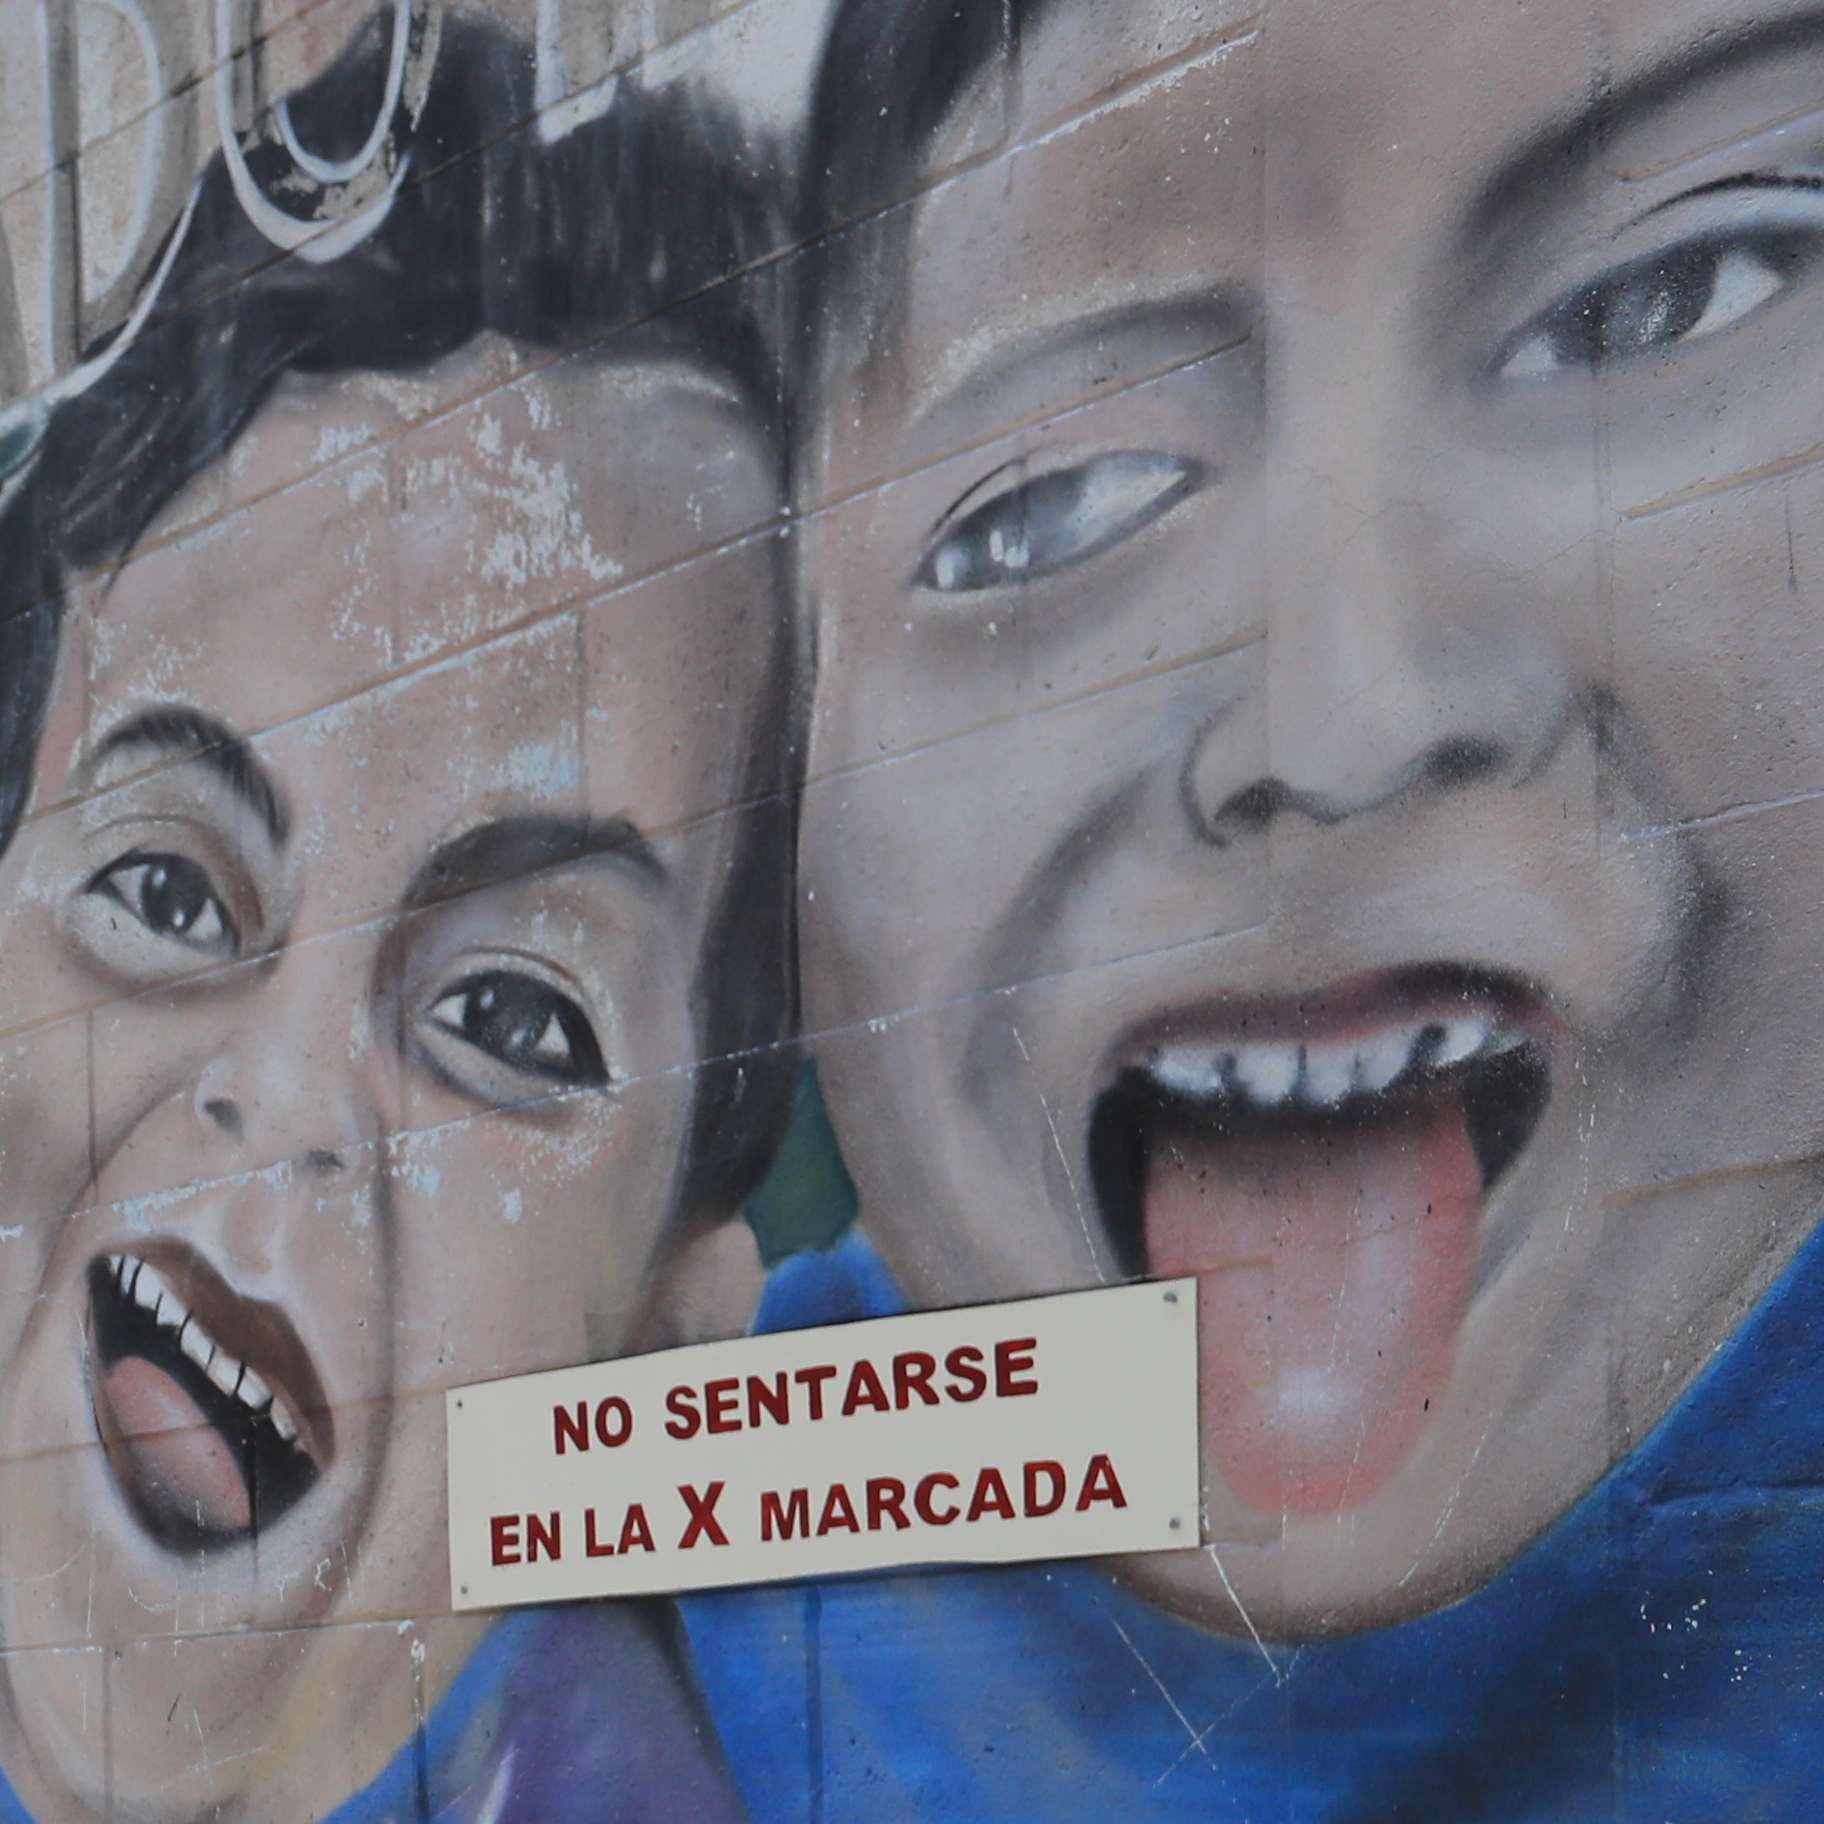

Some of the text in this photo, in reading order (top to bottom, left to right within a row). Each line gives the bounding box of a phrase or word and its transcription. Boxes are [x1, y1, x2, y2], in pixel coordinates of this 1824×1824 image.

[553, 1337, 1040, 1455] NO SENTARSE
[490, 1454, 1129, 1567] EN LA X MARCADA
